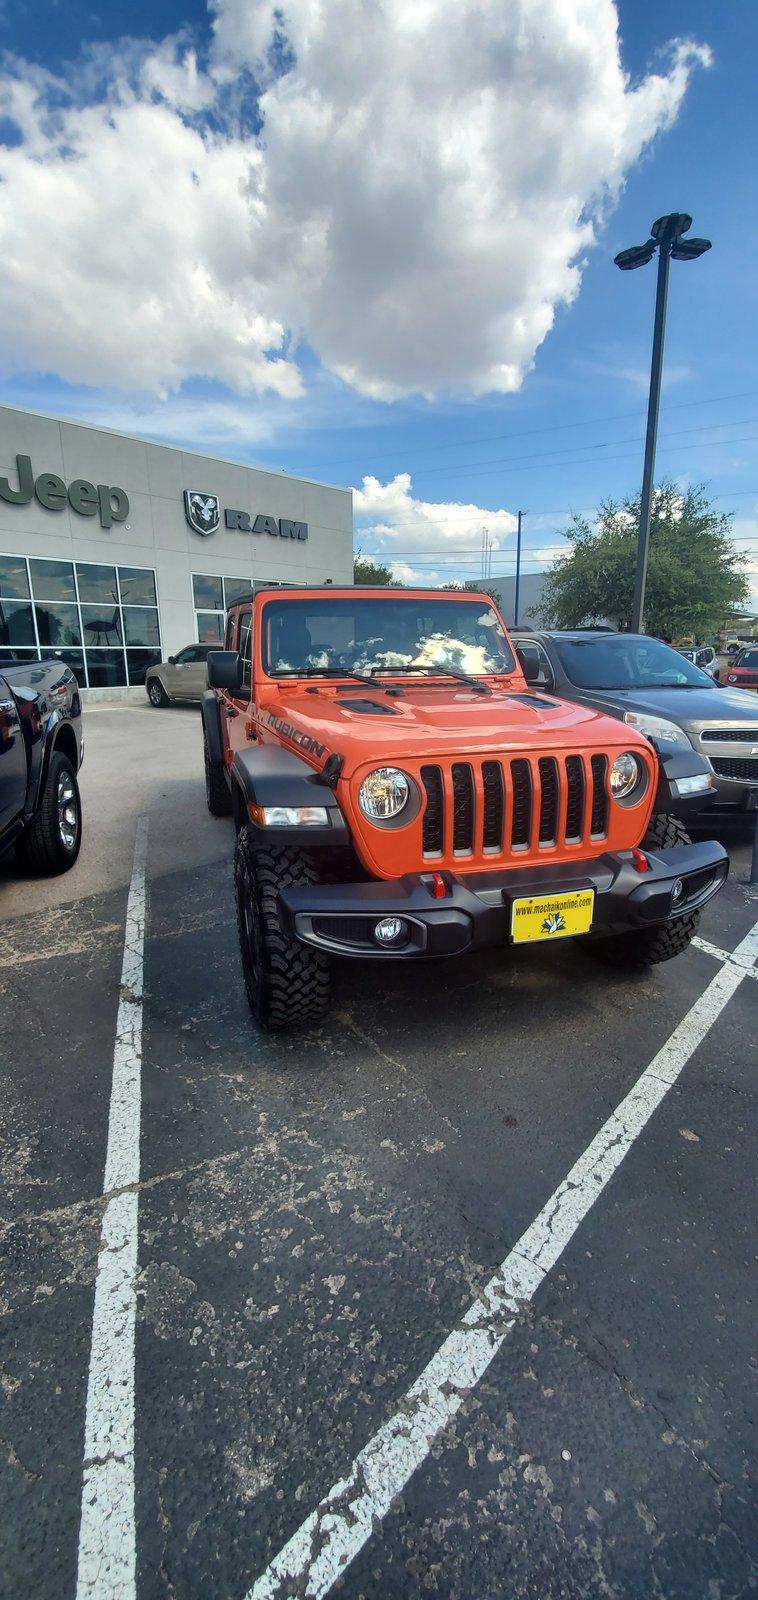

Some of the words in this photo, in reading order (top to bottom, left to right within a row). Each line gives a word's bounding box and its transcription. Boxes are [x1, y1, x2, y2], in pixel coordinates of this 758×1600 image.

[0, 454, 130, 528] Jeep
[225, 508, 309, 540] RAM
[267, 715, 326, 758] RUBICON
[515, 897, 592, 916] www.machaikonline.com
